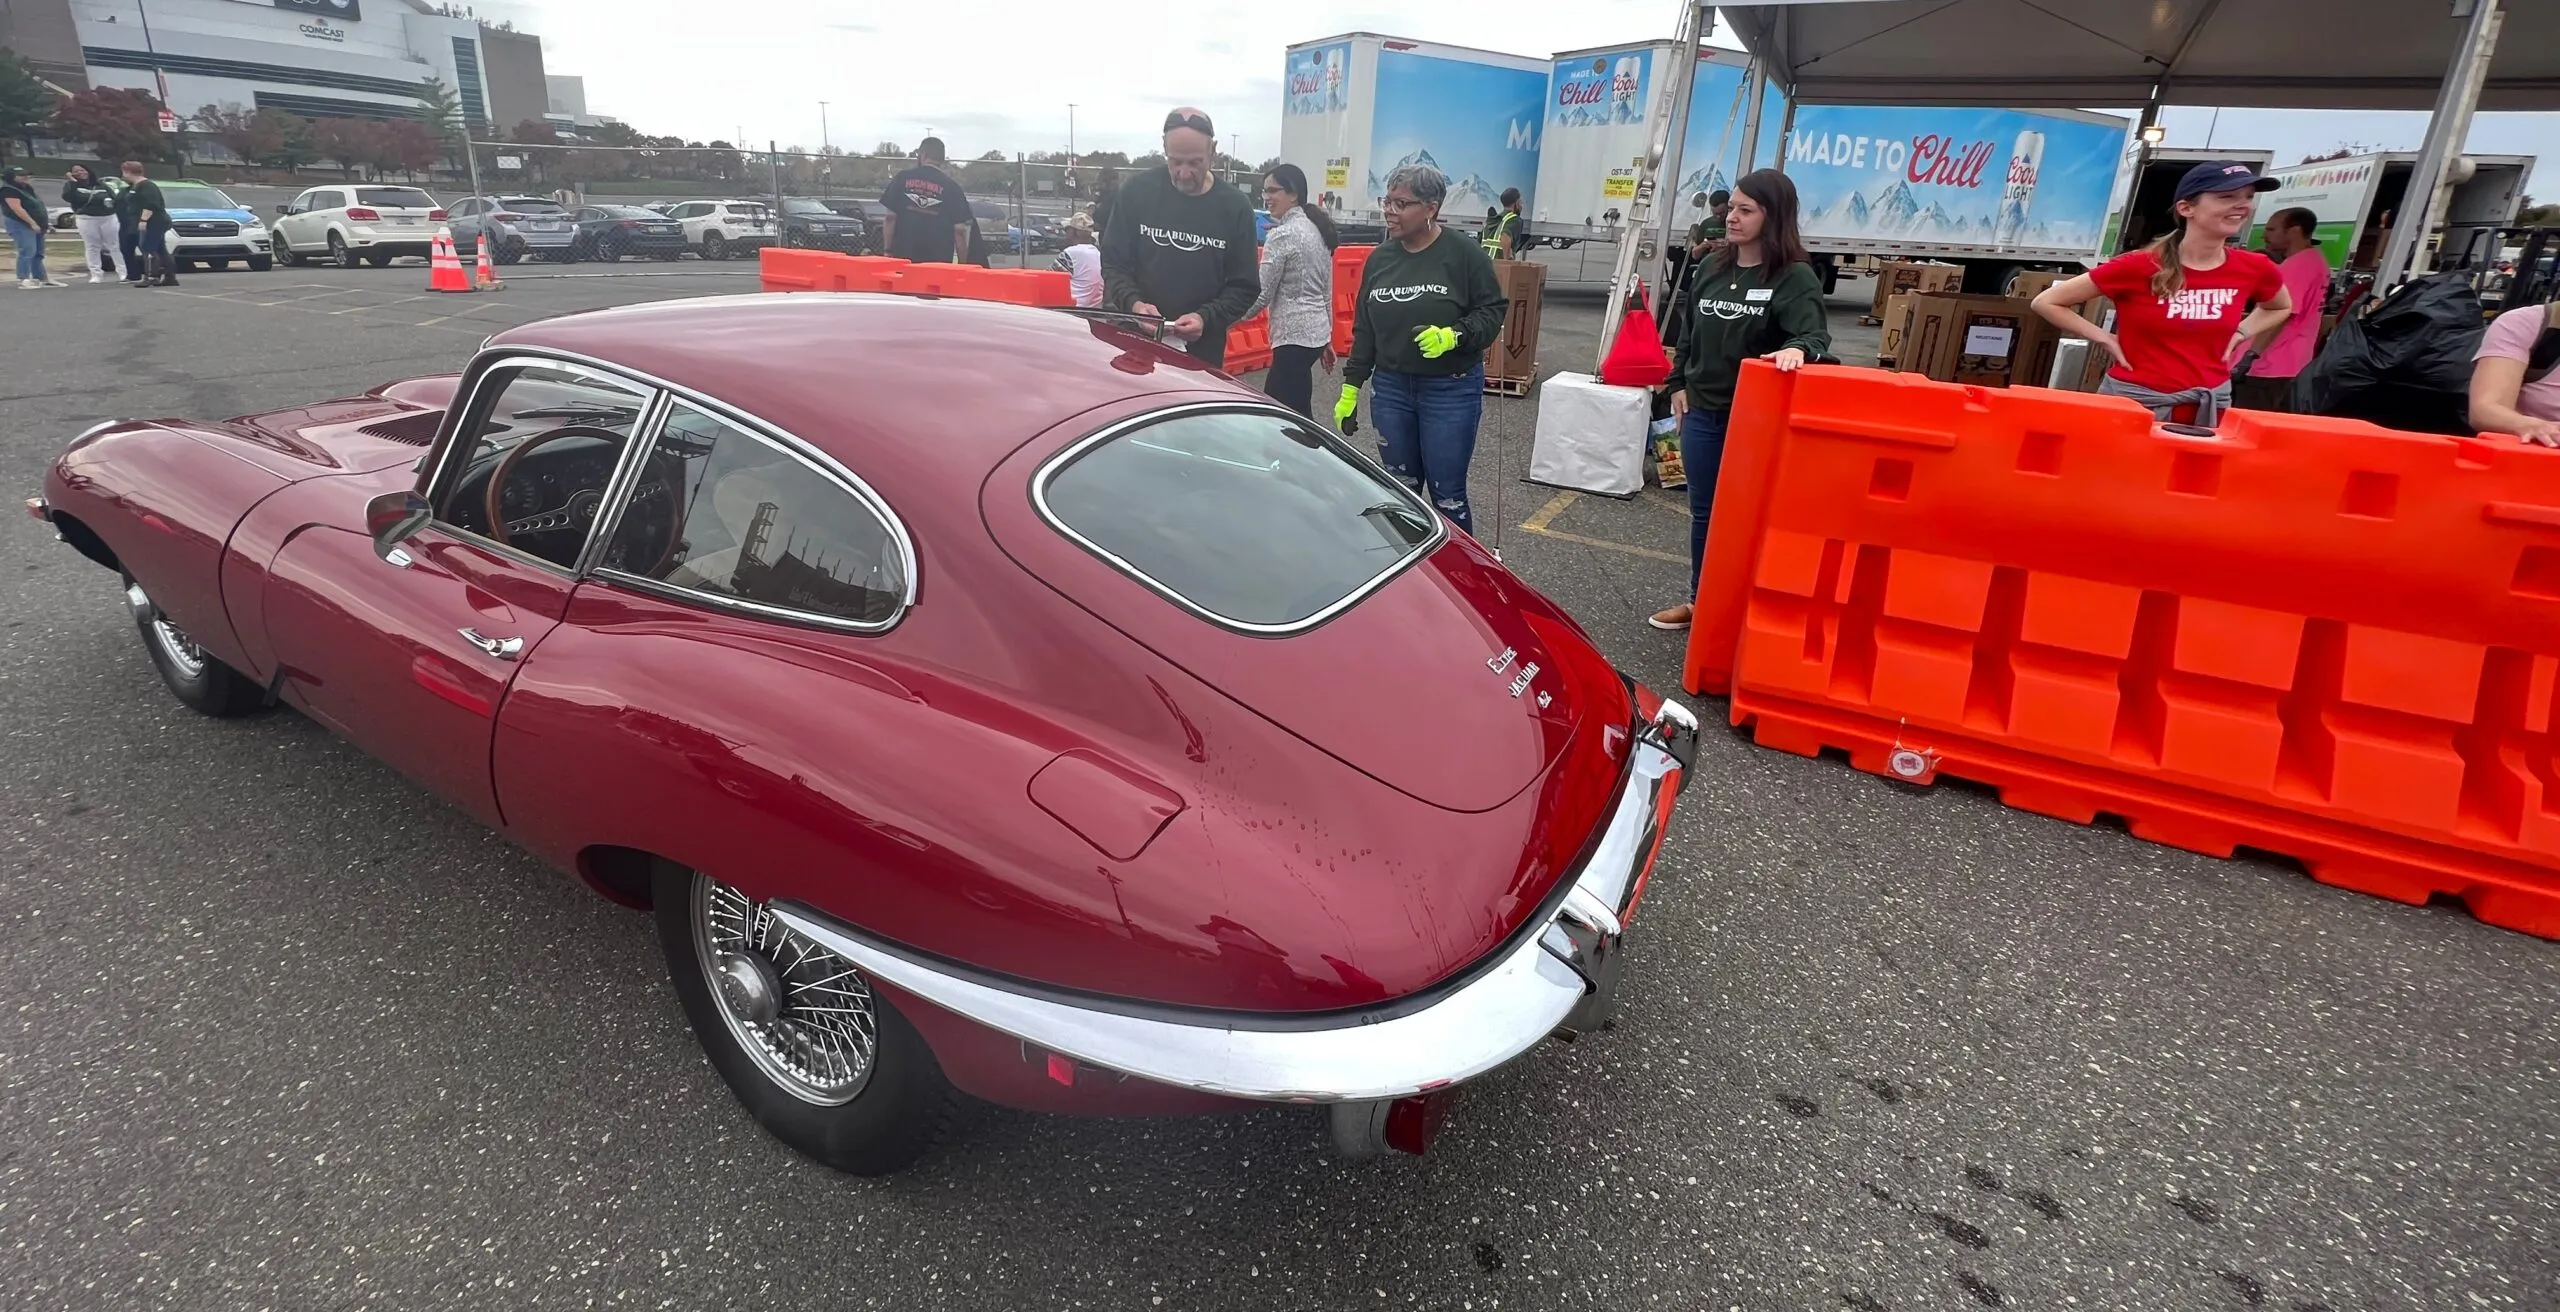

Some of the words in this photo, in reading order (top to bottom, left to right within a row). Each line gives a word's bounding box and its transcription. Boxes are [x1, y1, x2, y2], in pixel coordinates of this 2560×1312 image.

[299, 24, 344, 38] COMCAST
[1291, 72, 1321, 96] Chill
[1570, 70, 1590, 78] MADE
[1559, 79, 1607, 105] Chill
[1788, 129, 1868, 168] MADE
[1875, 138, 1906, 172] TO
[1907, 134, 1994, 188] Chill
[1606, 178, 1634, 186] TRANSFER
[1140, 223, 1226, 251] PHILABUNDANCE
[2166, 303, 2222, 320] PHILS
[1508, 661, 1540, 697] JAGUAR
